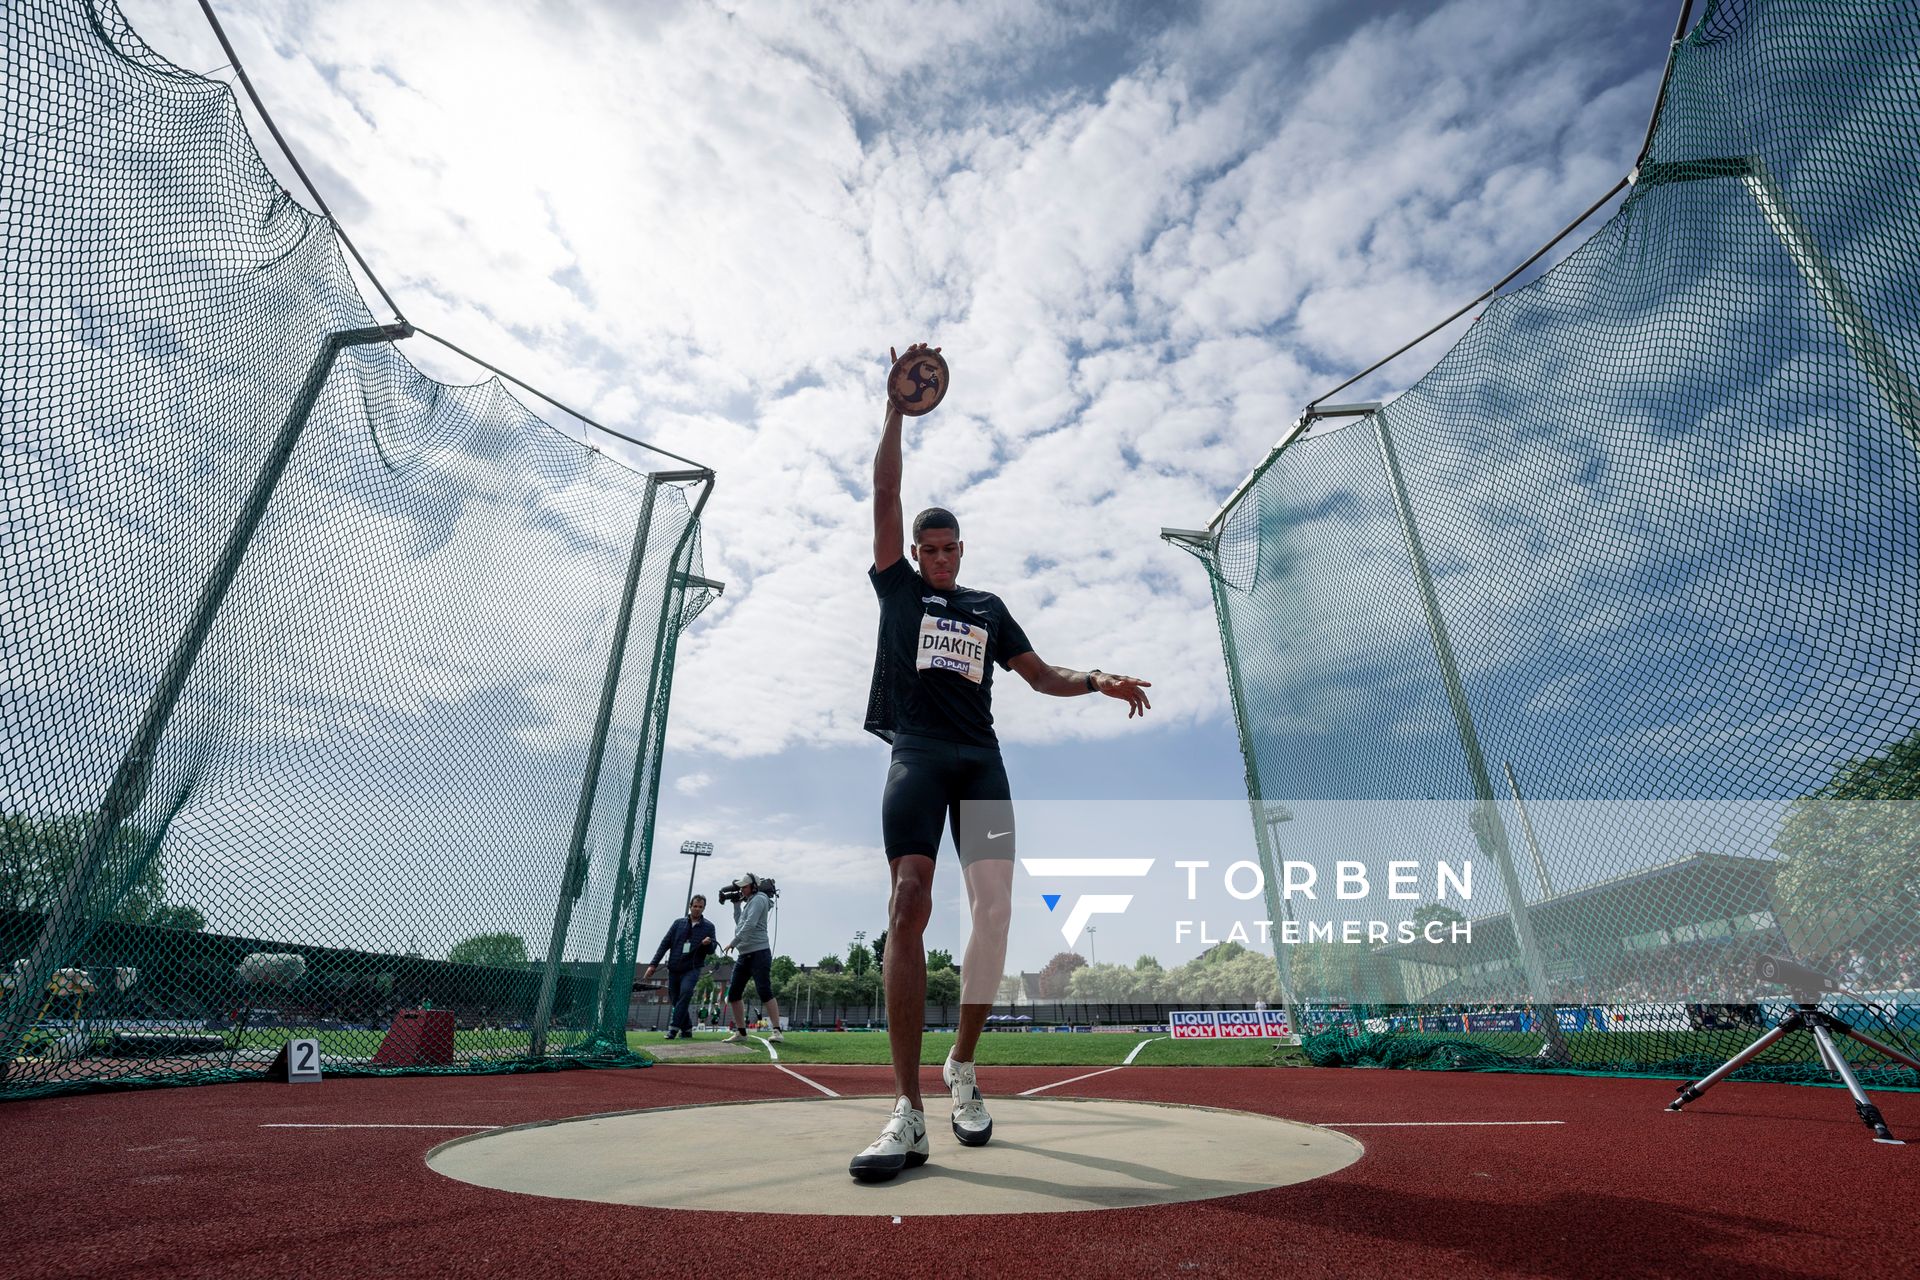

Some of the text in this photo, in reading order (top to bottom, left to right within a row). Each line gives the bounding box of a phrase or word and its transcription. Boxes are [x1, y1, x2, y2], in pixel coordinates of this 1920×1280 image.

[922, 634, 982, 661] DIAKITÉ
[947, 660, 969, 672] PLAN
[1174, 1014, 1213, 1025] LIQUI
[1218, 1013, 1258, 1024] LIQUI
[1264, 1012, 1287, 1024] LIQ
[1175, 1025, 1215, 1037] MOLY
[1220, 1025, 1262, 1036] MOLY
[1266, 1024, 1290, 1036] MO
[296, 1042, 315, 1071] 2
